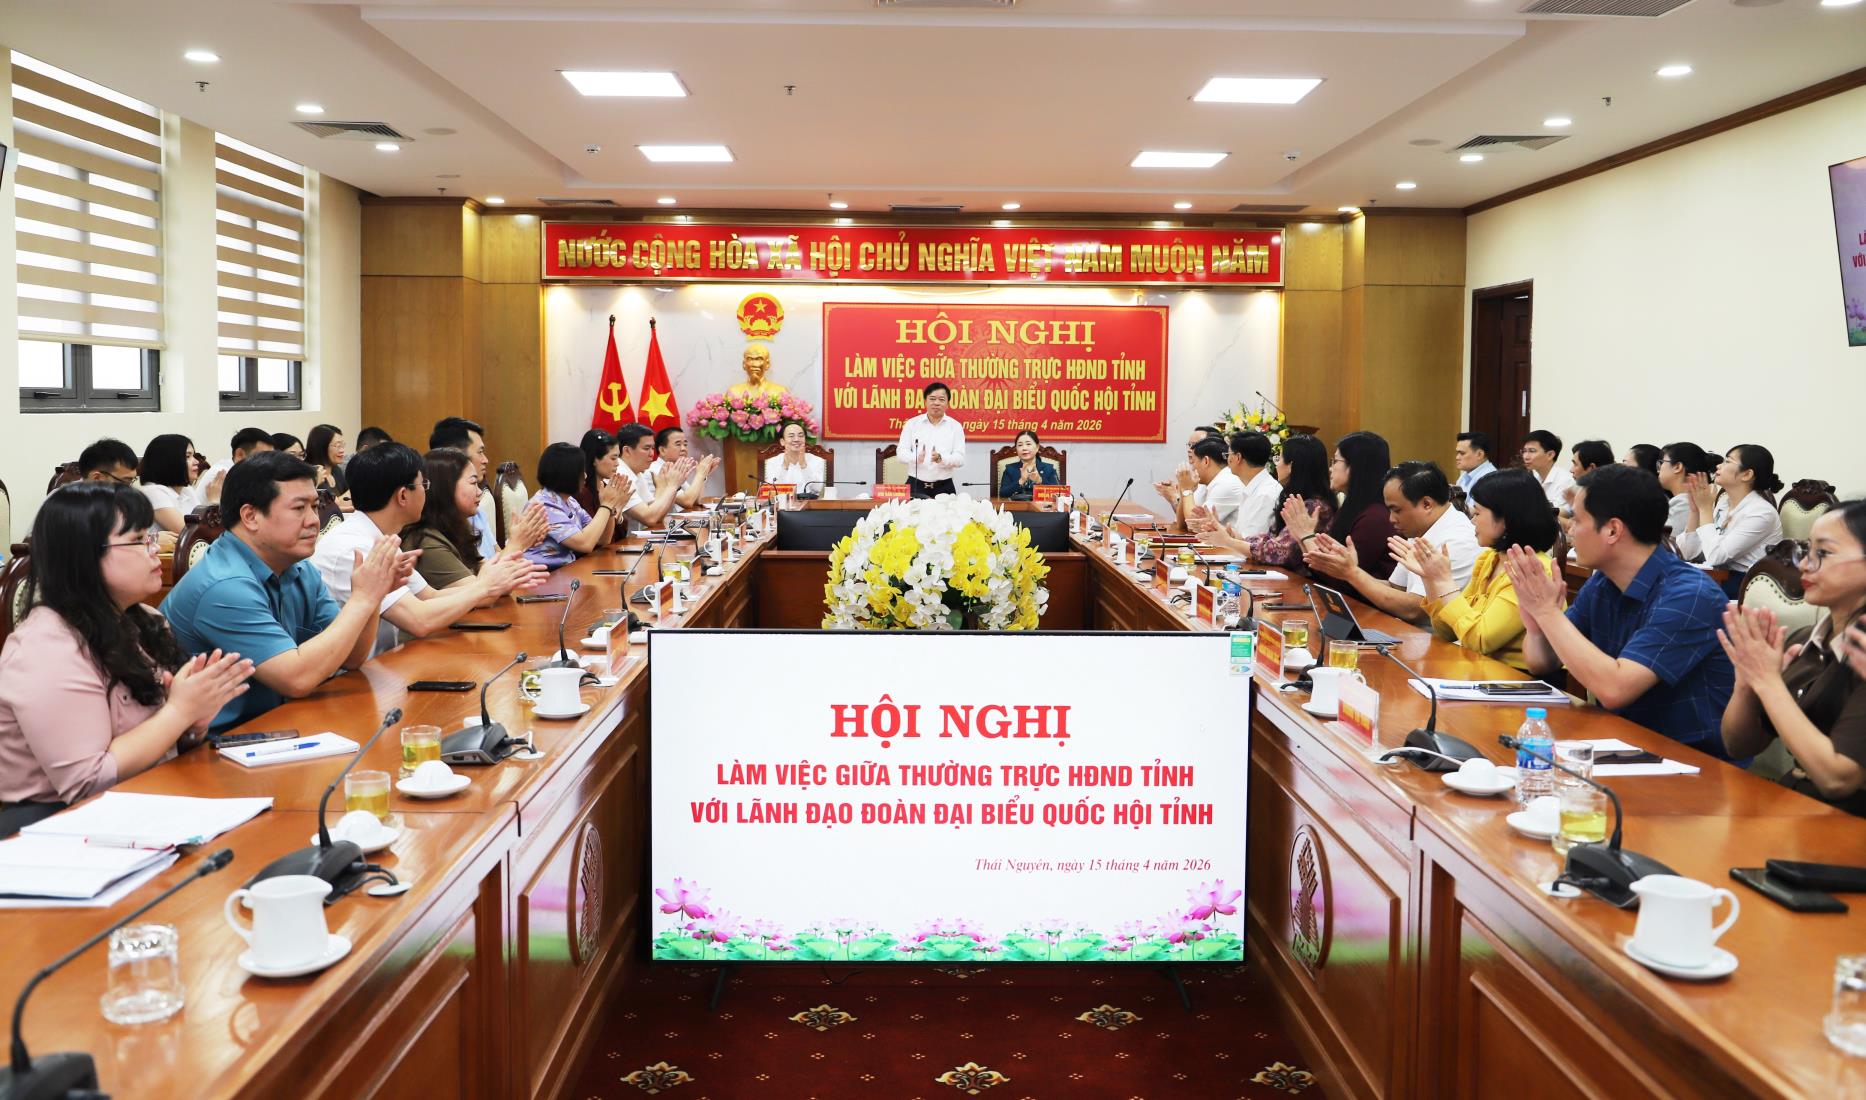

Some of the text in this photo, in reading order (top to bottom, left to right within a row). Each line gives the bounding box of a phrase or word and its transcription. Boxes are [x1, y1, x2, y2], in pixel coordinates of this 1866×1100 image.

[558, 229, 1270, 279] NƯỚC CỘNG HÒA XÃ HỘI CHỦ NGHĨA VIỆT NAM MUÔN NĂM
[895, 311, 1096, 353] HỘI NGHỊ
[844, 351, 1146, 384] LÀM VIỆC GIỮA THƯỜNG TRỰC HĐND TỈNH
[834, 381, 1156, 415] VỚI LÃNH ĐẠ OÀN ĐẠI BIỂU QUỐC HỘI TỈNH
[962, 418, 989, 432] ngày
[993, 418, 1005, 430] 15
[1007, 418, 1038, 432] tháng
[1041, 420, 1048, 430] 4
[1051, 419, 1074, 430] năm
[1076, 419, 1103, 431] 2026
[831, 694, 1071, 748] HỘI NGHỊ
[717, 758, 1194, 791] LÀM VIỆC GIỮA THƯỜNG TRỰC HĐND TỈNH
[691, 795, 1214, 830] VỚI LÃNH ĐẠO ĐOÀN ĐẠI BIỂU QUỐC HỘI TỈNH
[975, 858, 1002, 871] Thái
[1057, 859, 1085, 873] ngày
[1089, 859, 1102, 871] 15
[1105, 858, 1140, 873] tháng
[1143, 859, 1151, 871] 4
[1153, 860, 1179, 871] năm
[1182, 859, 1212, 871] 2026
